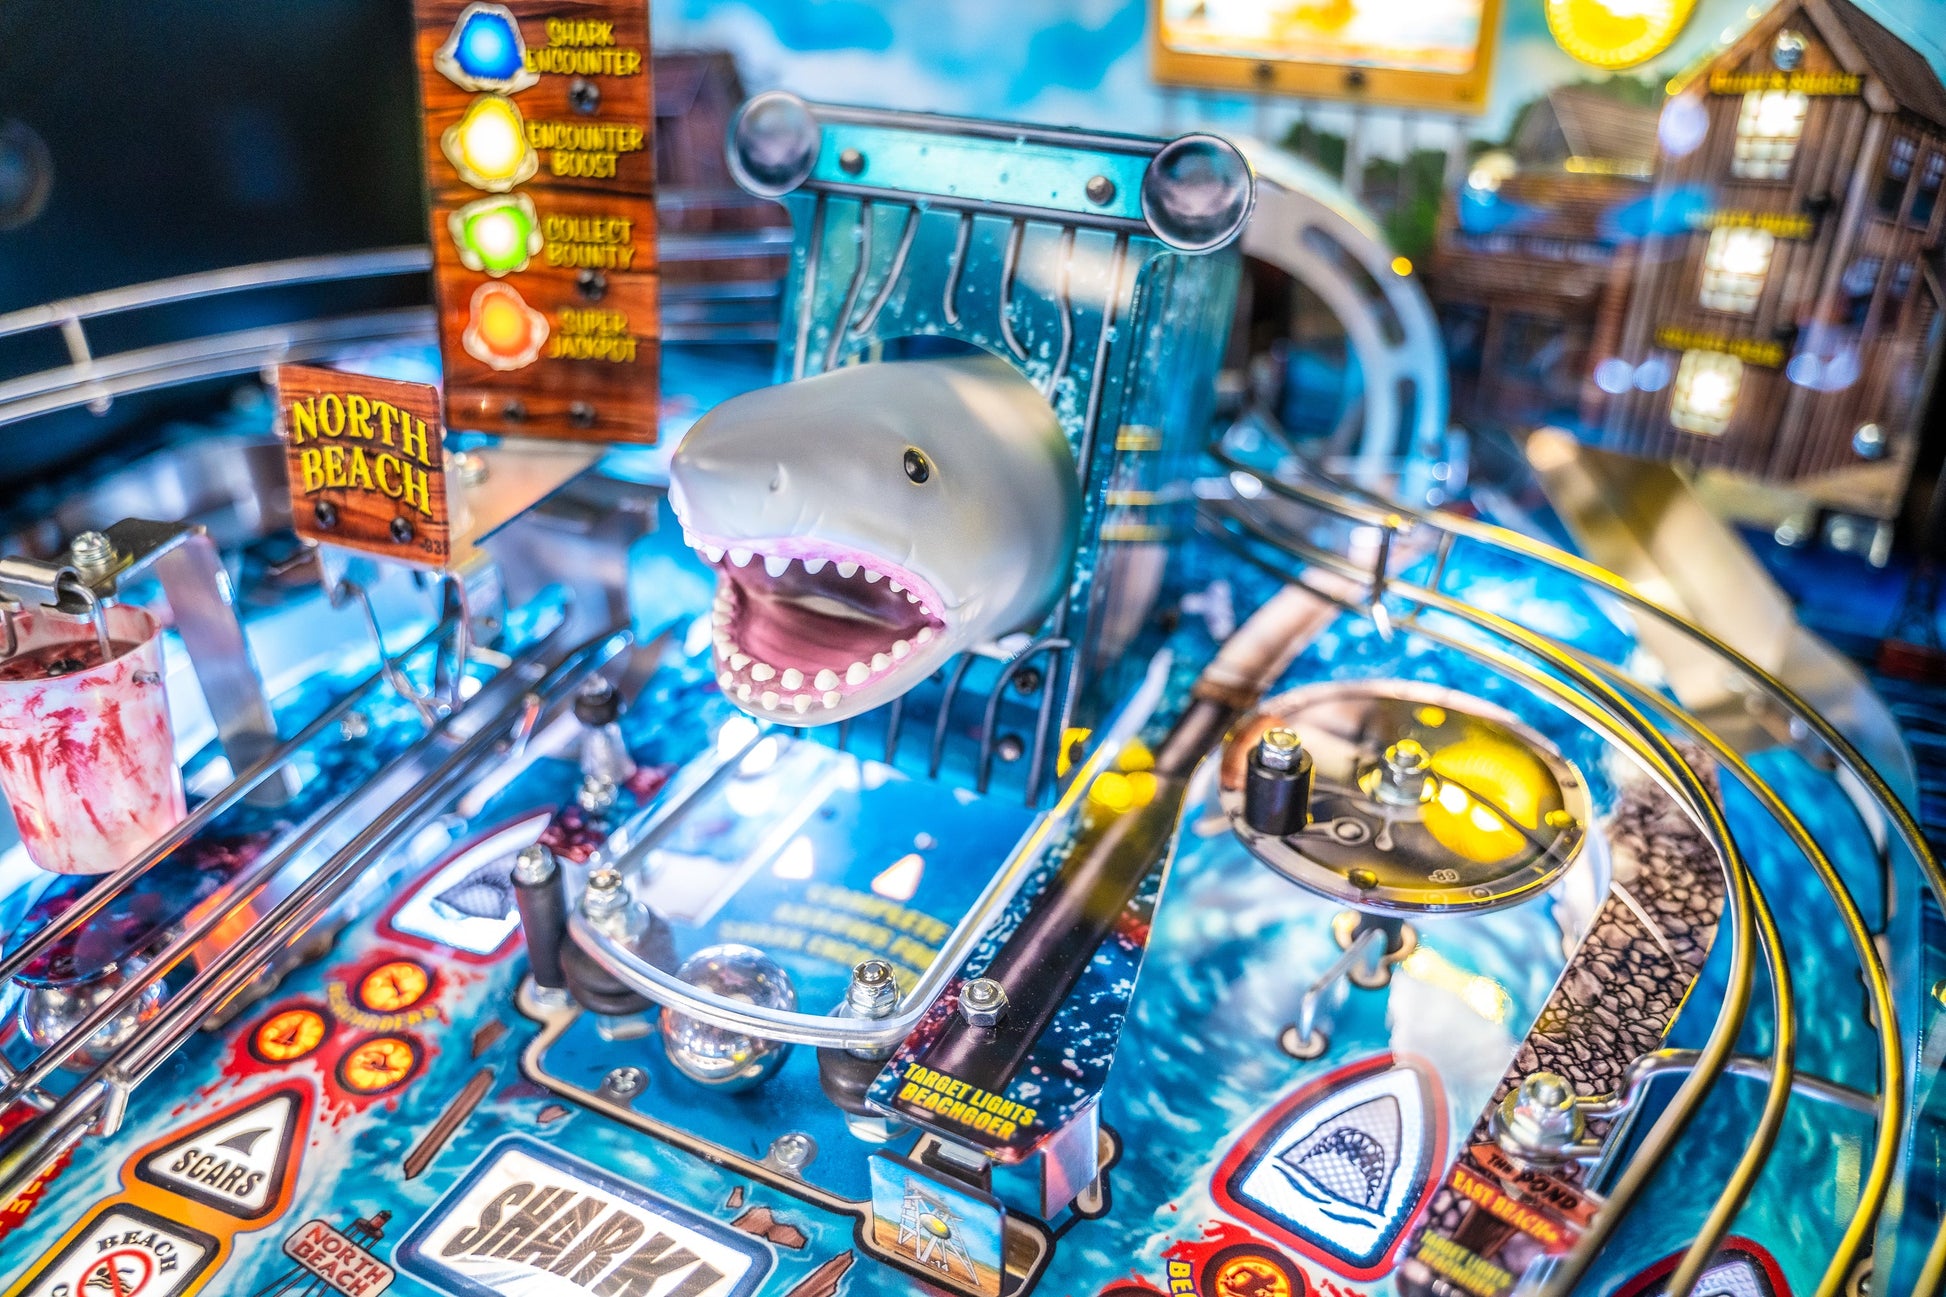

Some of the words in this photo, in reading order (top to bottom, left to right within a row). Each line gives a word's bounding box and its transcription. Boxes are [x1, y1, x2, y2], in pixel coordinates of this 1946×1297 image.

[545, 17, 615, 47] SHARK
[525, 48, 641, 76] ENCOUNTER
[525, 120, 643, 152] ENCOUNTER
[552, 151, 620, 178] BOOST
[545, 215, 634, 244] COLLECT
[545, 242, 635, 269] BOUNTY
[560, 308, 629, 336] SUPER
[548, 334, 638, 363] JACKPOT
[293, 393, 431, 466] NORTH
[301, 446, 433, 517] BEACH
[899, 1082, 1018, 1141] BEACHGOER
[903, 1062, 972, 1100] TARGET
[969, 1089, 1037, 1126] LIGHTS
[171, 1149, 265, 1197] SCARS
[1513, 1170, 1578, 1210] POND
[1452, 1170, 1493, 1207] EAST
[1491, 1195, 1547, 1242] BEACH
[97, 1230, 179, 1275] BEACH
[291, 1240, 370, 1297] BEACH
[305, 1225, 388, 1285] NORTH
